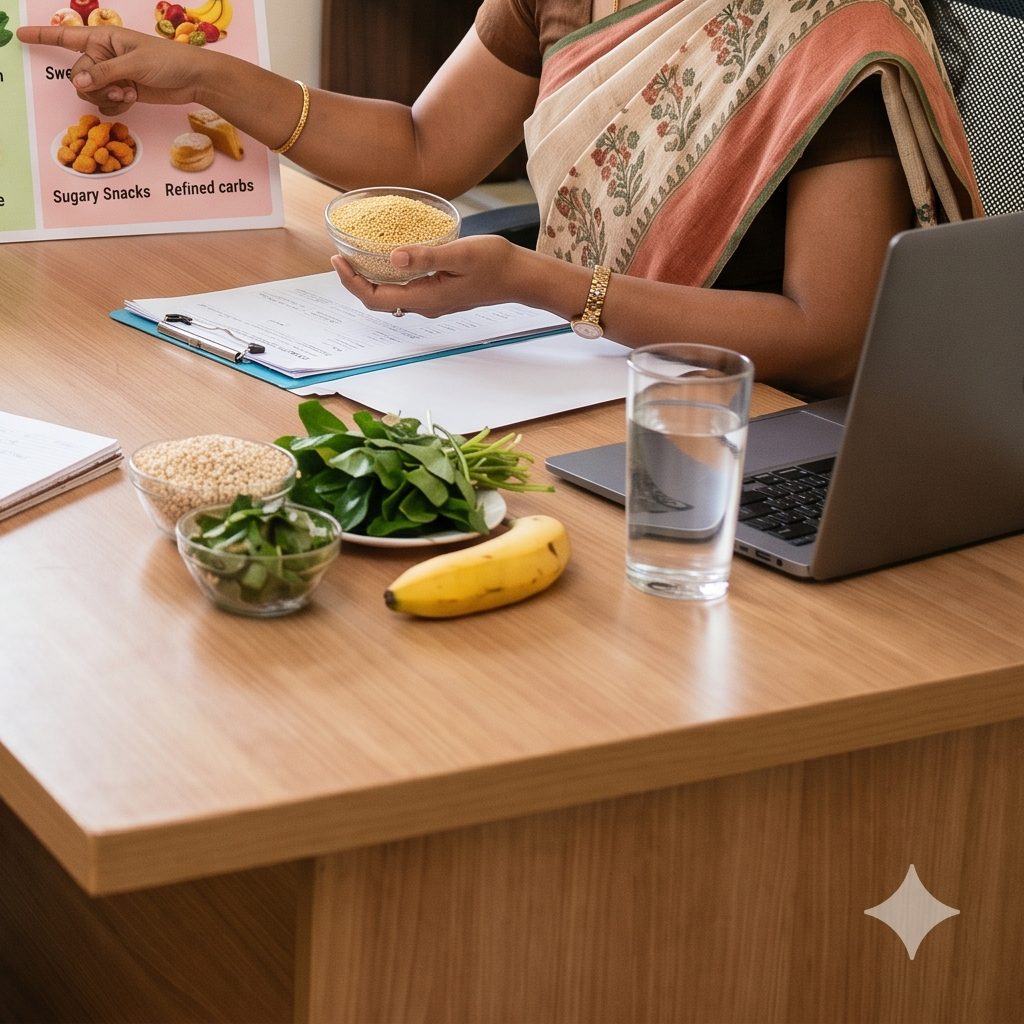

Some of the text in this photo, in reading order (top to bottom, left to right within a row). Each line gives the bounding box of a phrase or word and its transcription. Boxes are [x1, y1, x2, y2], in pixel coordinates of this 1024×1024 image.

[45, 66, 72, 80] Swe
[53, 184, 151, 206] Sugary Snacks
[165, 178, 255, 197] Refined carbs
